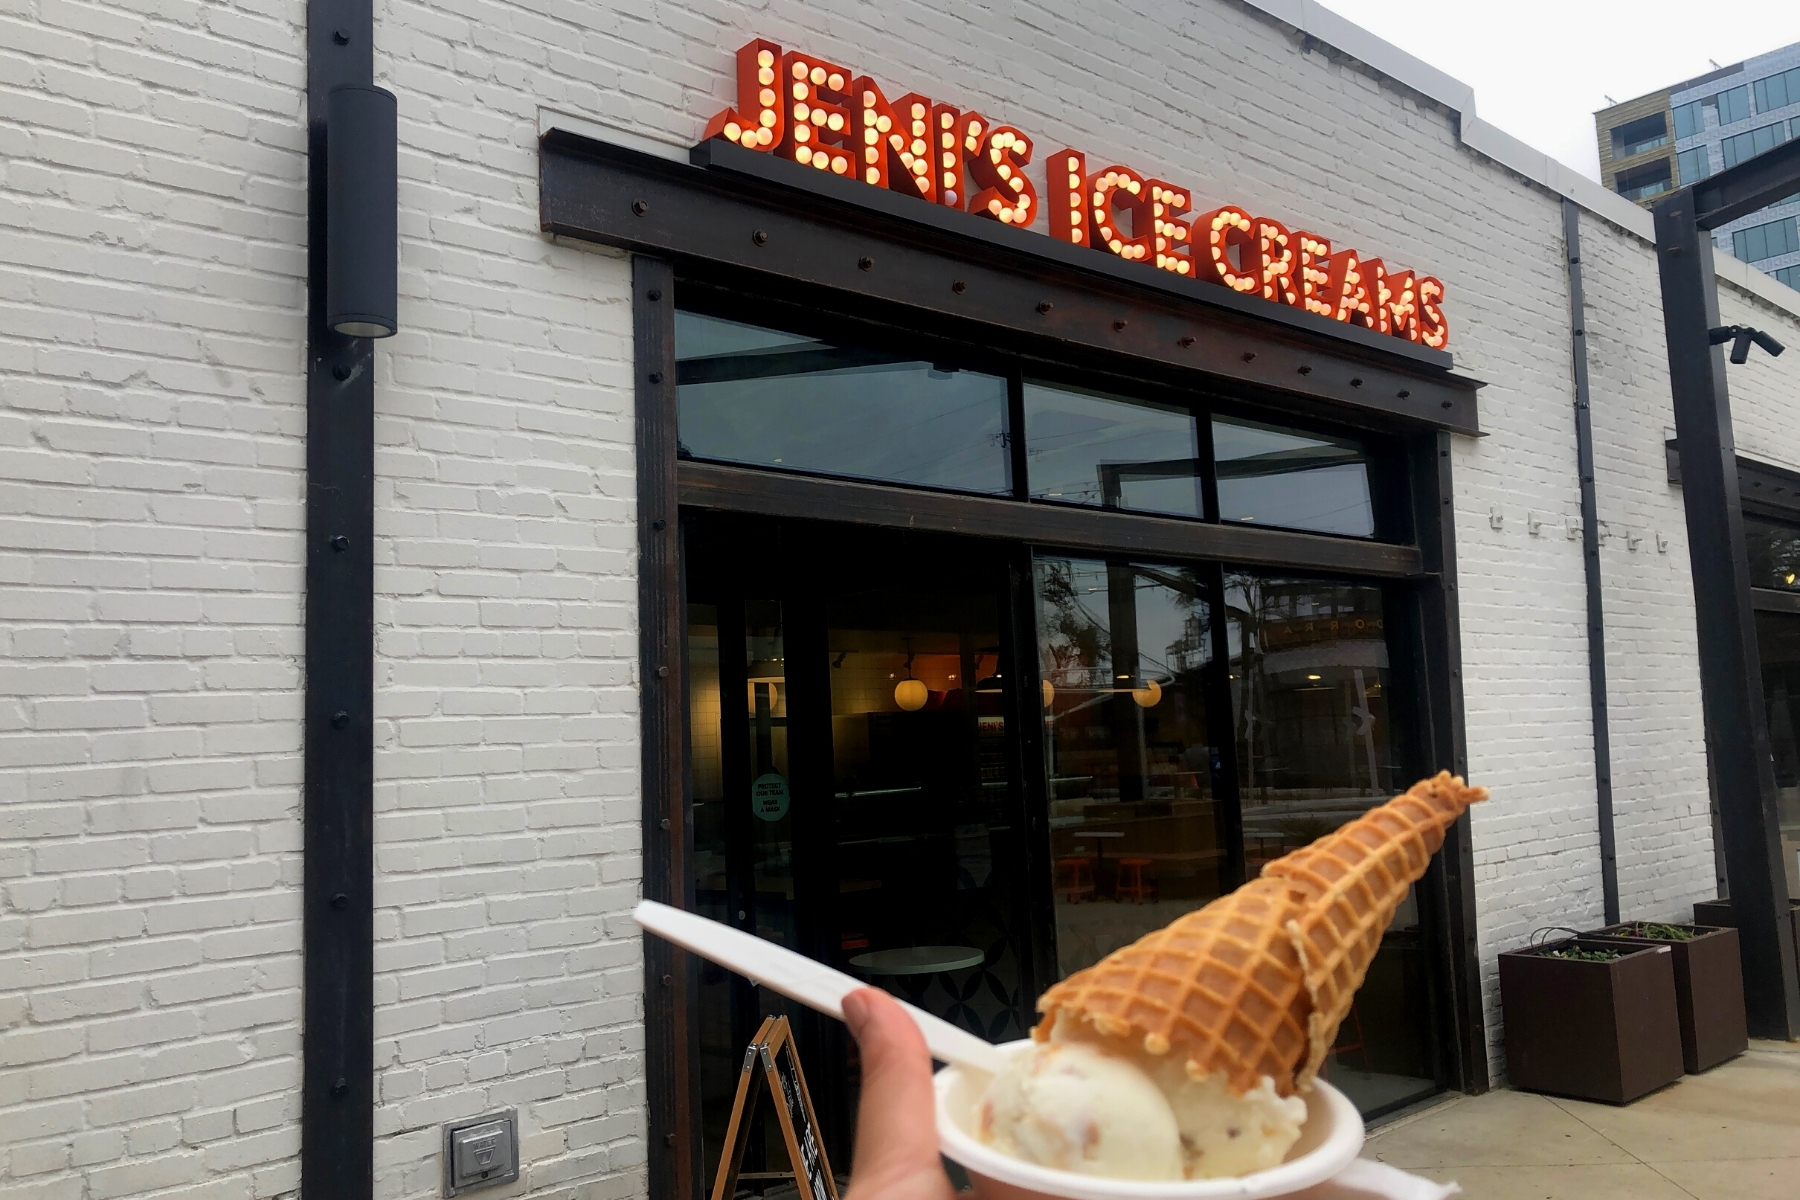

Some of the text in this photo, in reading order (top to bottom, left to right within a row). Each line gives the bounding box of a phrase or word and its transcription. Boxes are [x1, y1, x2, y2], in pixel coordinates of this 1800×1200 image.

[704, 38, 1449, 350] JENI'S ICE CREAMS
[473, 1138, 497, 1149] WATER
